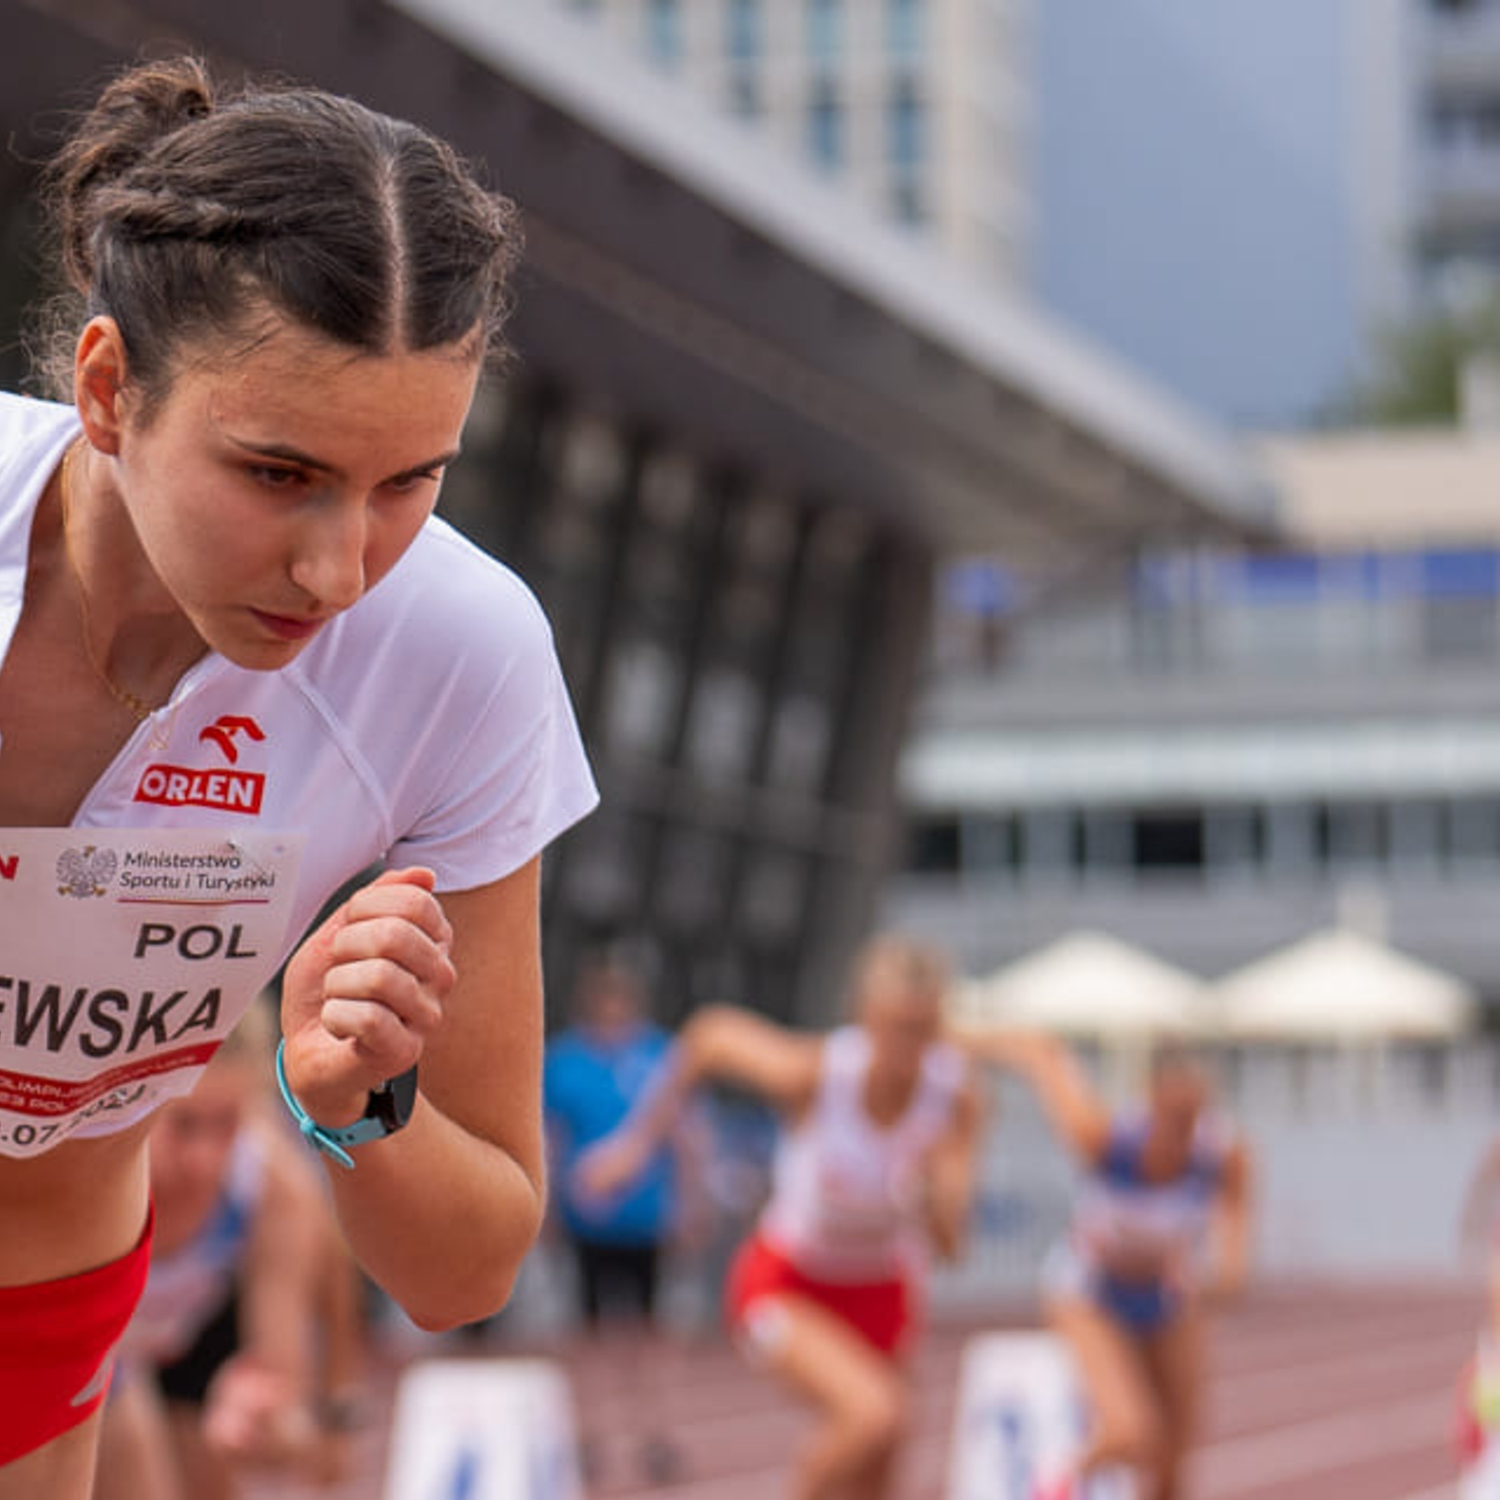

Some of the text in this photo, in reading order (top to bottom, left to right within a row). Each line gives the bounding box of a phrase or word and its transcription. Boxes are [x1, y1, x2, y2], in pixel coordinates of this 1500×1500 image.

[141, 770, 256, 808] ORLEN
[124, 851, 242, 870] Ministerstwo
[119, 871, 276, 892] Sportu i Turystyki
[133, 922, 258, 961] POL
